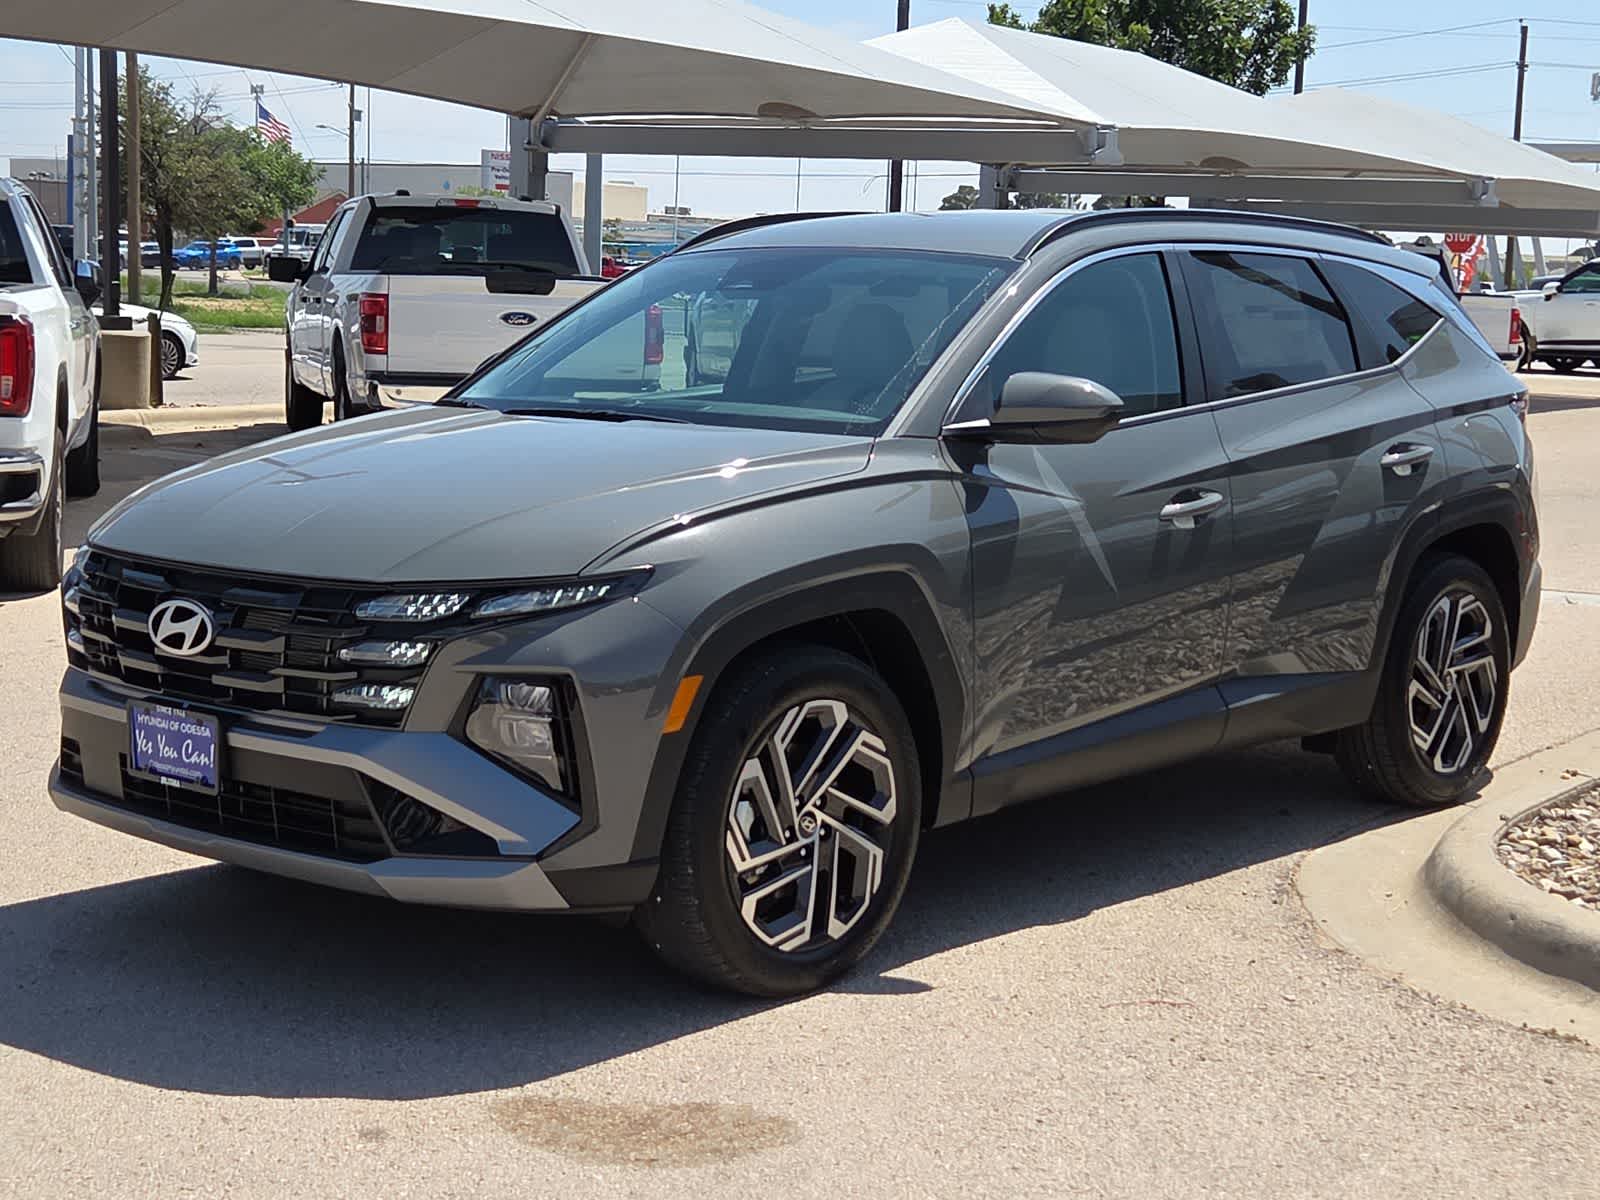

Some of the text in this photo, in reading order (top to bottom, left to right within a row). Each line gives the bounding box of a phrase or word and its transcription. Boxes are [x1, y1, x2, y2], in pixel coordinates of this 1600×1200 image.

[137, 713, 211, 737] HYUNDAI OF ODESSA
[135, 729, 215, 768] Yes You Can!
